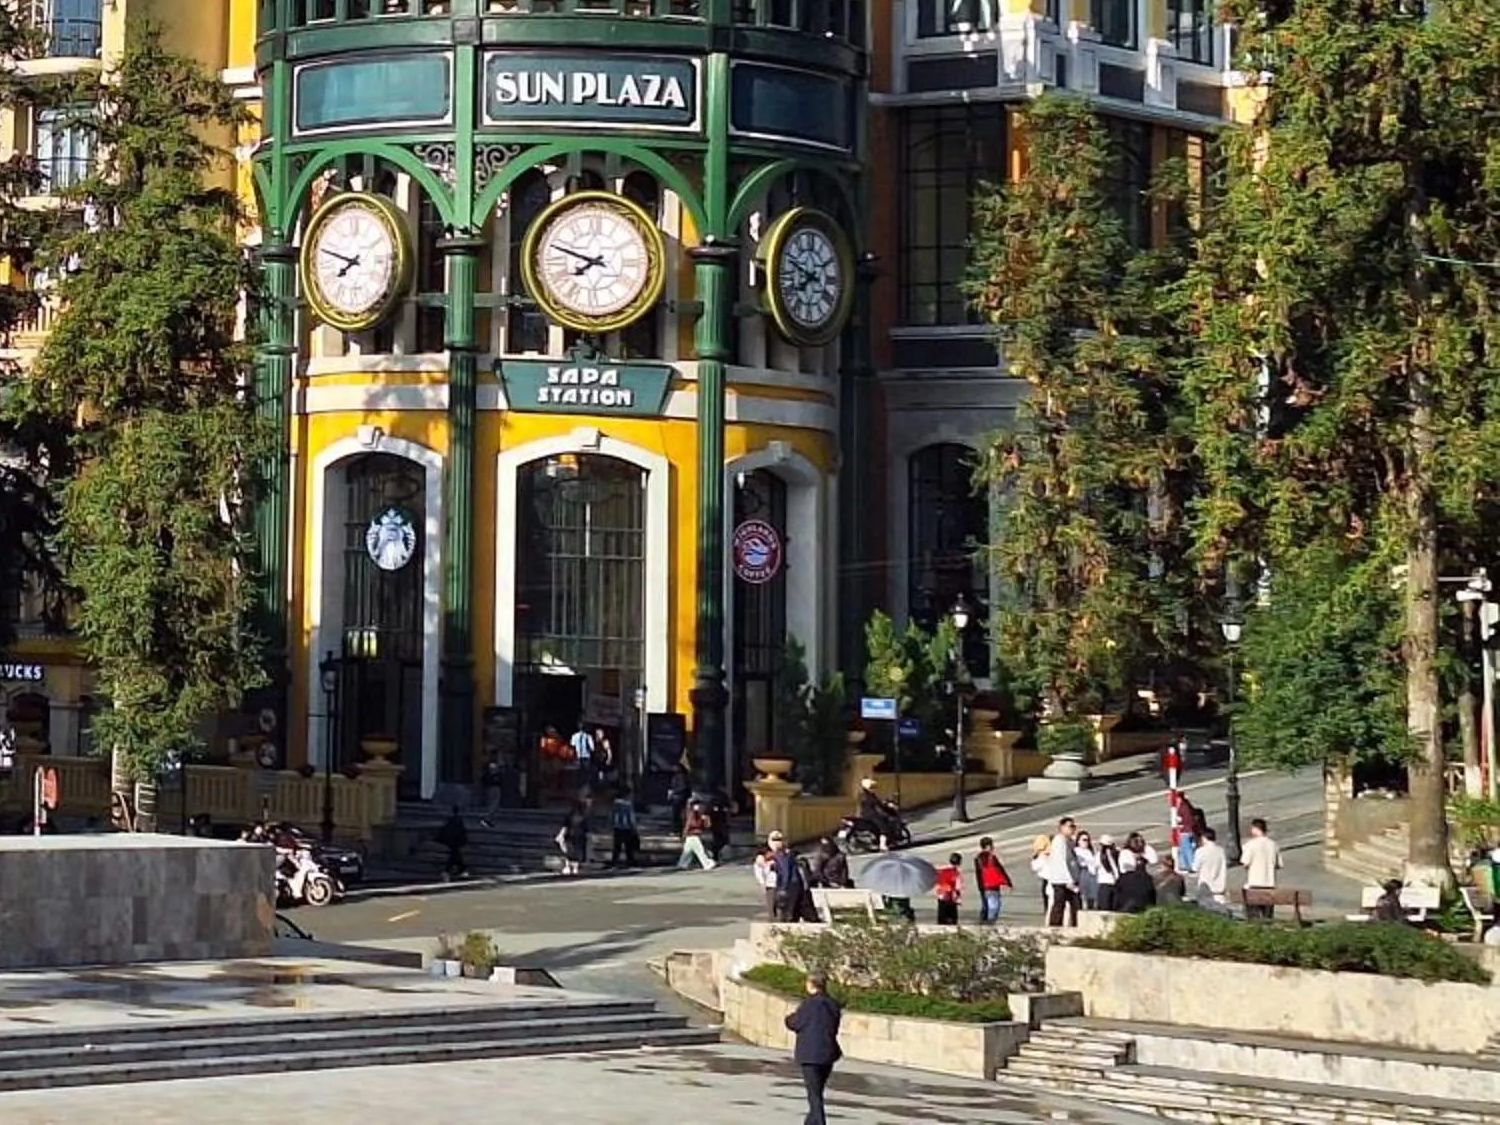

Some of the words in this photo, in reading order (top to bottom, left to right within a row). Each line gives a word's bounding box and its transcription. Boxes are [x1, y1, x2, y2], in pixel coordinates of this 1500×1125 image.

[496, 72, 564, 104] SUN
[572, 73, 685, 108] PLAZA
[547, 366, 618, 386] SAPA
[537, 386, 633, 406] STATION
